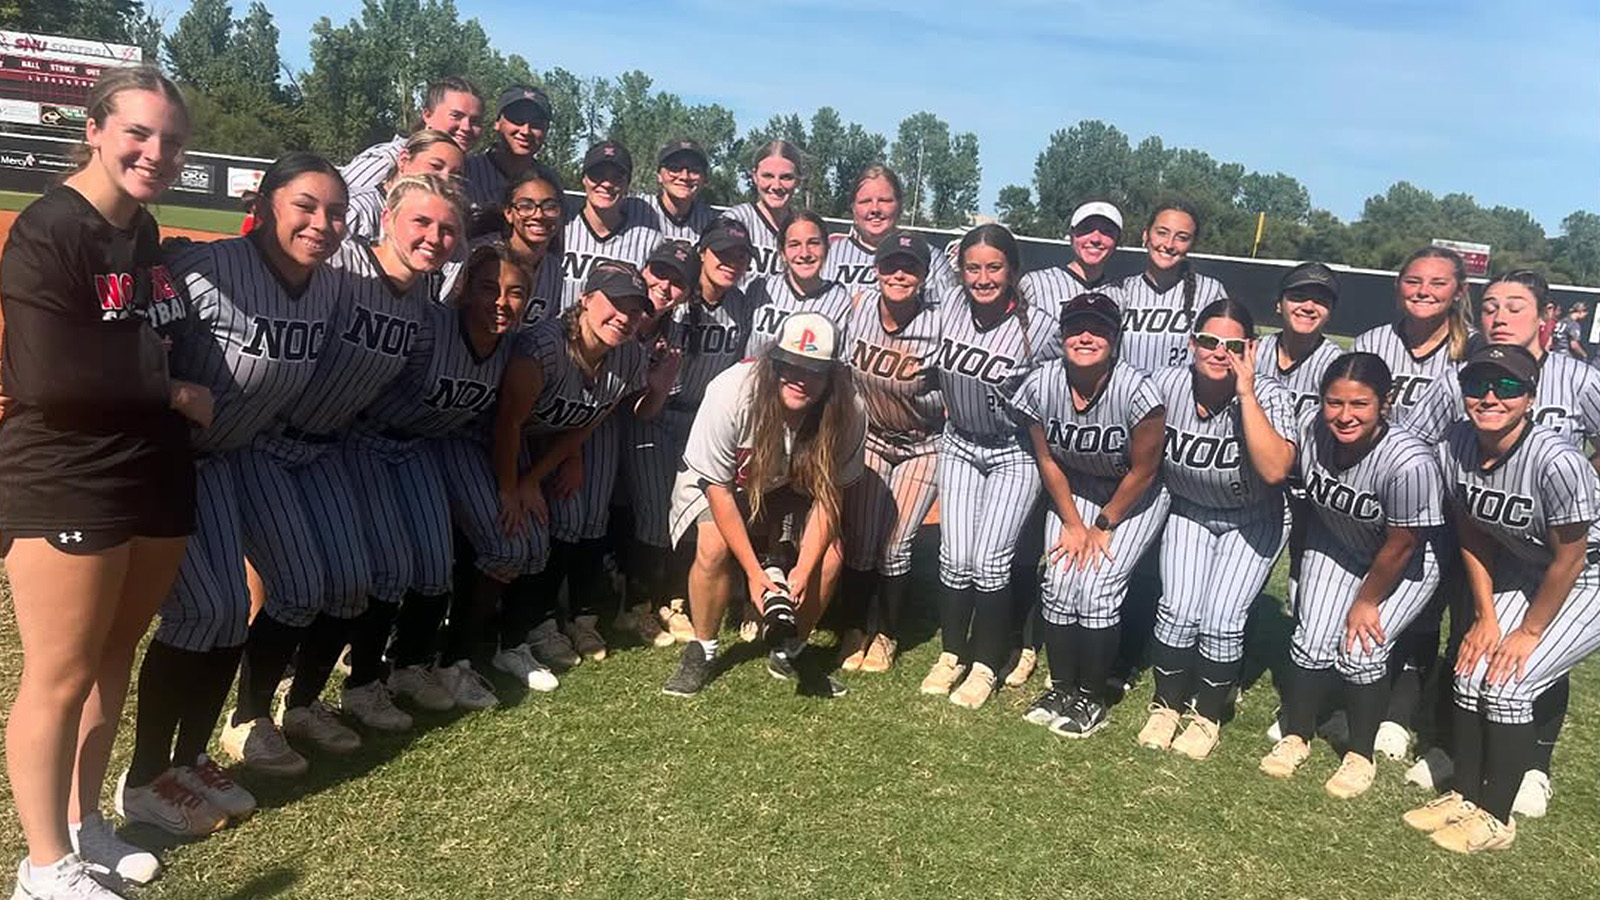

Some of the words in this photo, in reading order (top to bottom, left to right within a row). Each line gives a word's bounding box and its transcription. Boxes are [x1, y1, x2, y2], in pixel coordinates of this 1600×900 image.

[21, 61, 40, 69] BALL
[1, 155, 27, 167] Mercy
[241, 316, 325, 362] NOC
[850, 338, 926, 382] NOC
[935, 337, 1016, 386] NOC
[1046, 418, 1127, 455] NOC
[1163, 424, 1243, 471] NOC
[1305, 470, 1383, 522] NOC
